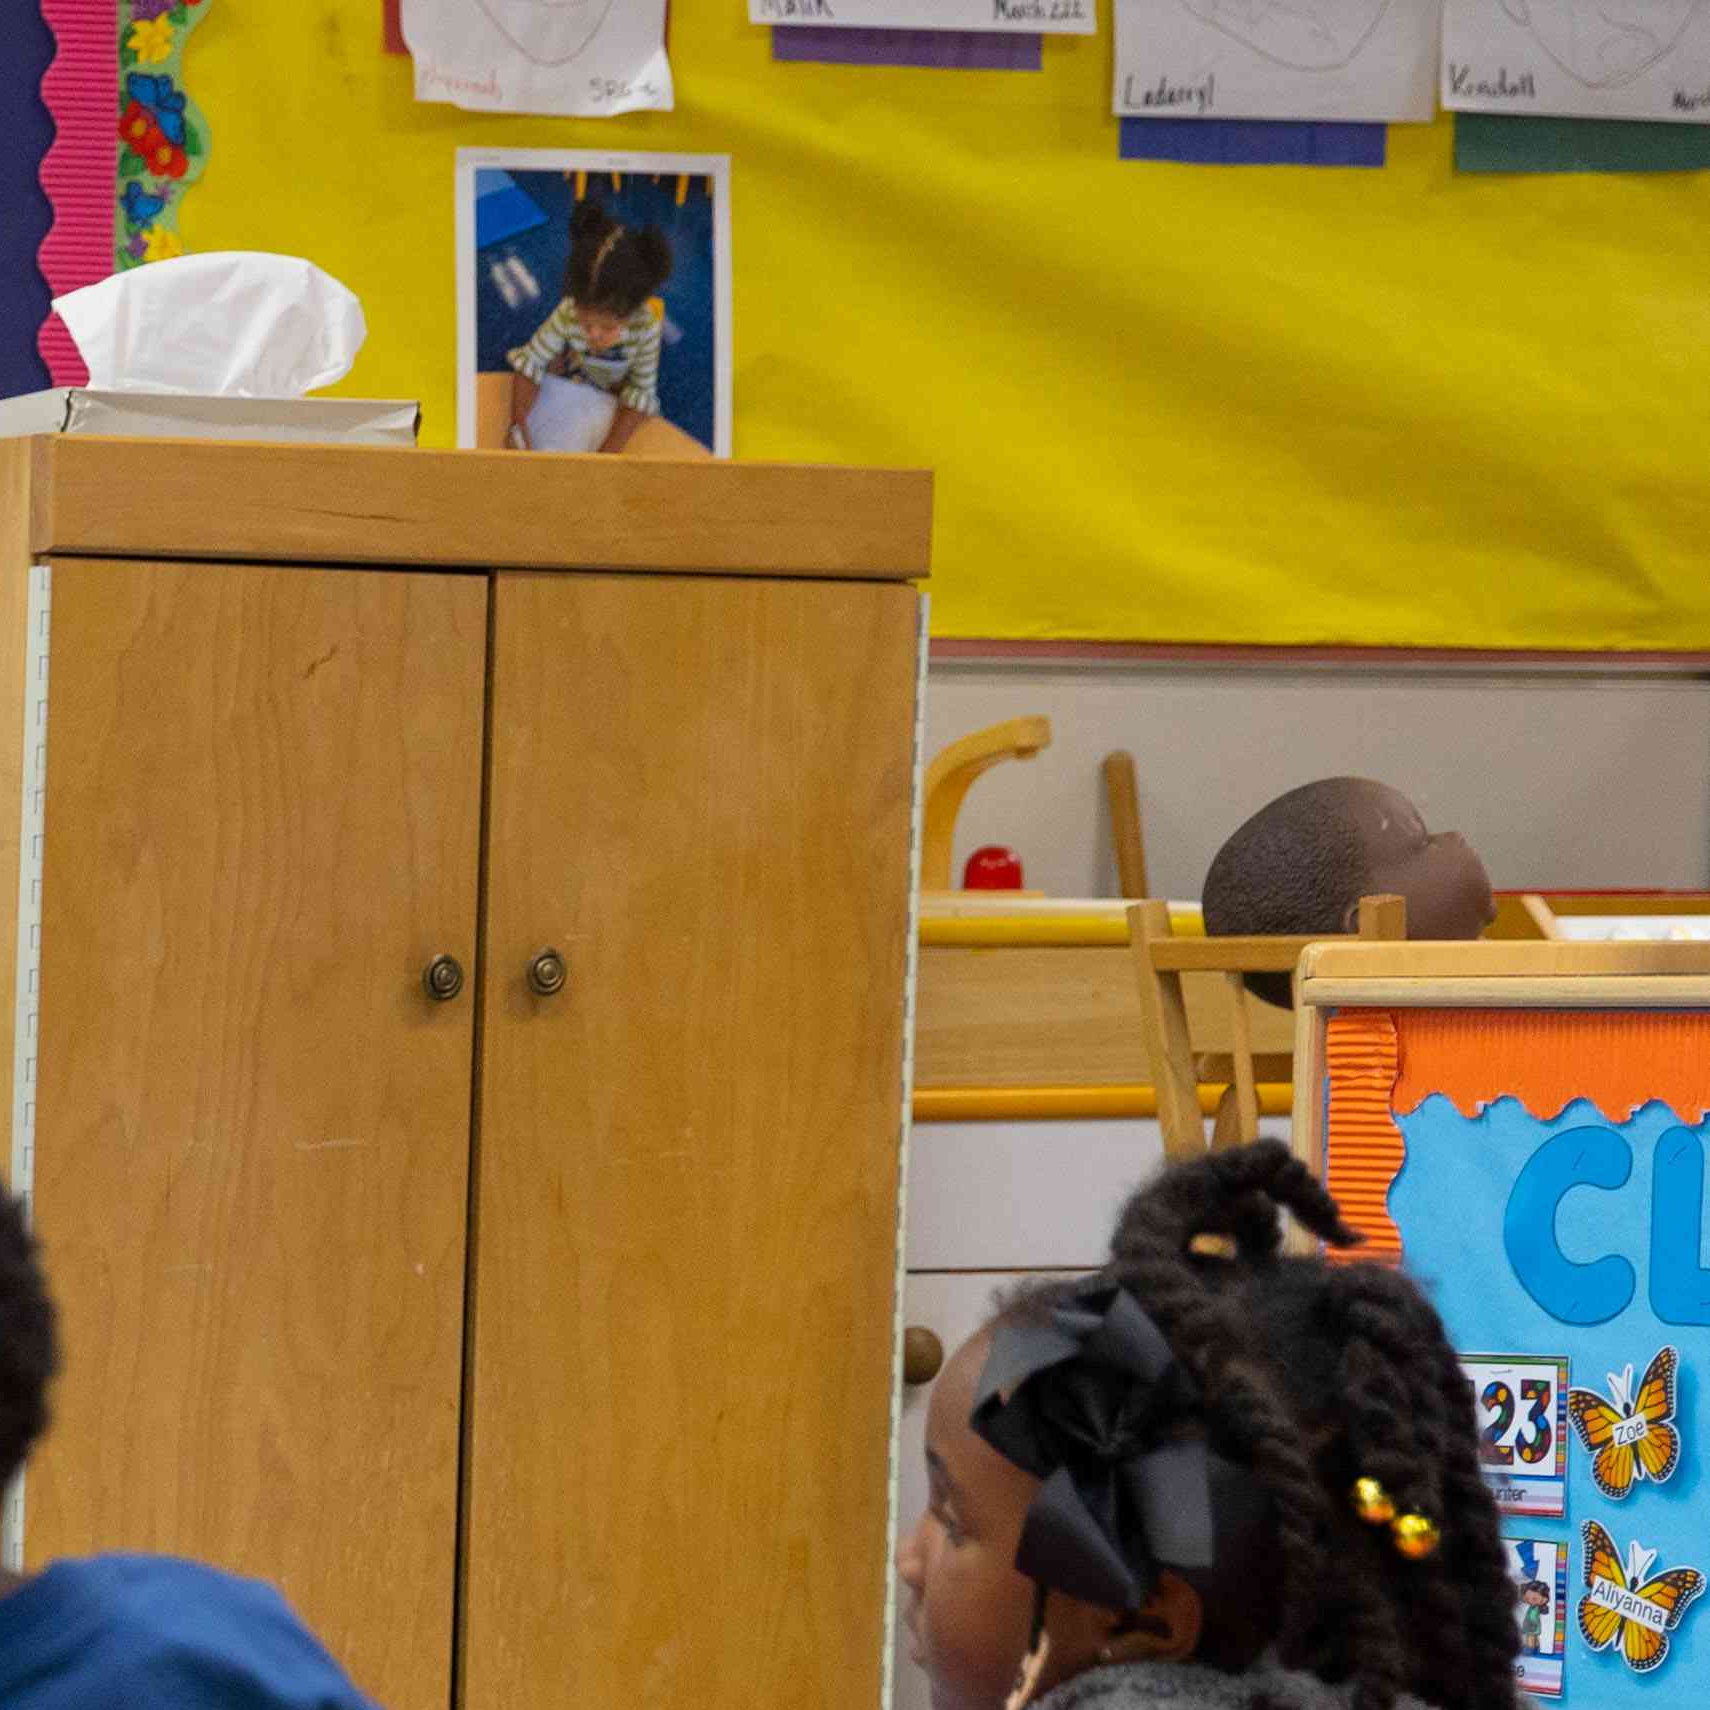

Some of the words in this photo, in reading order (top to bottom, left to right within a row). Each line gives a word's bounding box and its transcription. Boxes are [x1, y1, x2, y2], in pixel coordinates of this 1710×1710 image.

[1468, 1379, 1552, 1465] 23
[1615, 1422, 1646, 1446] Zoe
[1593, 1579, 1665, 1627] Aliyanna
